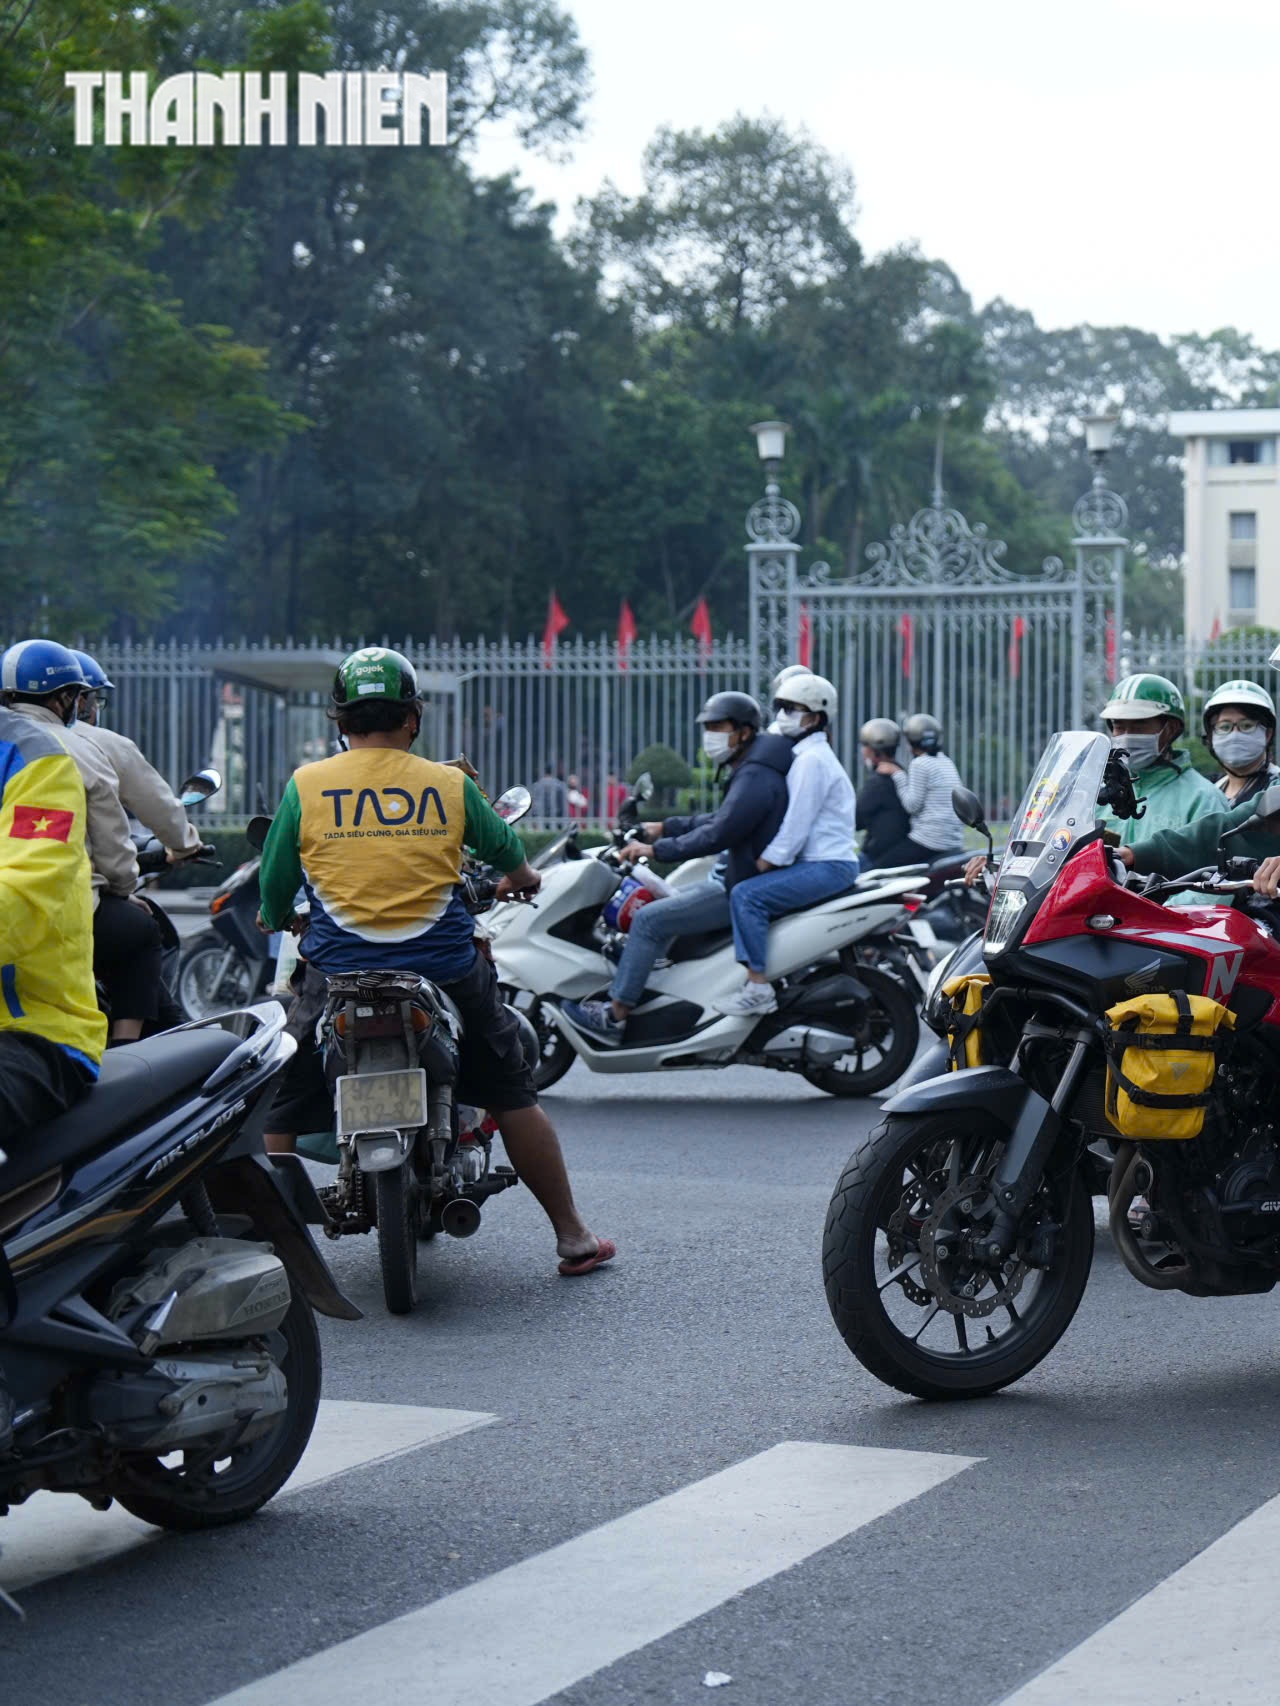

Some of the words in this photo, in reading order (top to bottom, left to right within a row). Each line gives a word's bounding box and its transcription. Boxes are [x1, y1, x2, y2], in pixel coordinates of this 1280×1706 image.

[356, 664, 384, 676] gojek
[321, 786, 448, 827] TADA
[323, 832, 346, 840] TADA
[145, 1144, 184, 1180] AIR
[184, 1098, 246, 1150] BLADE
